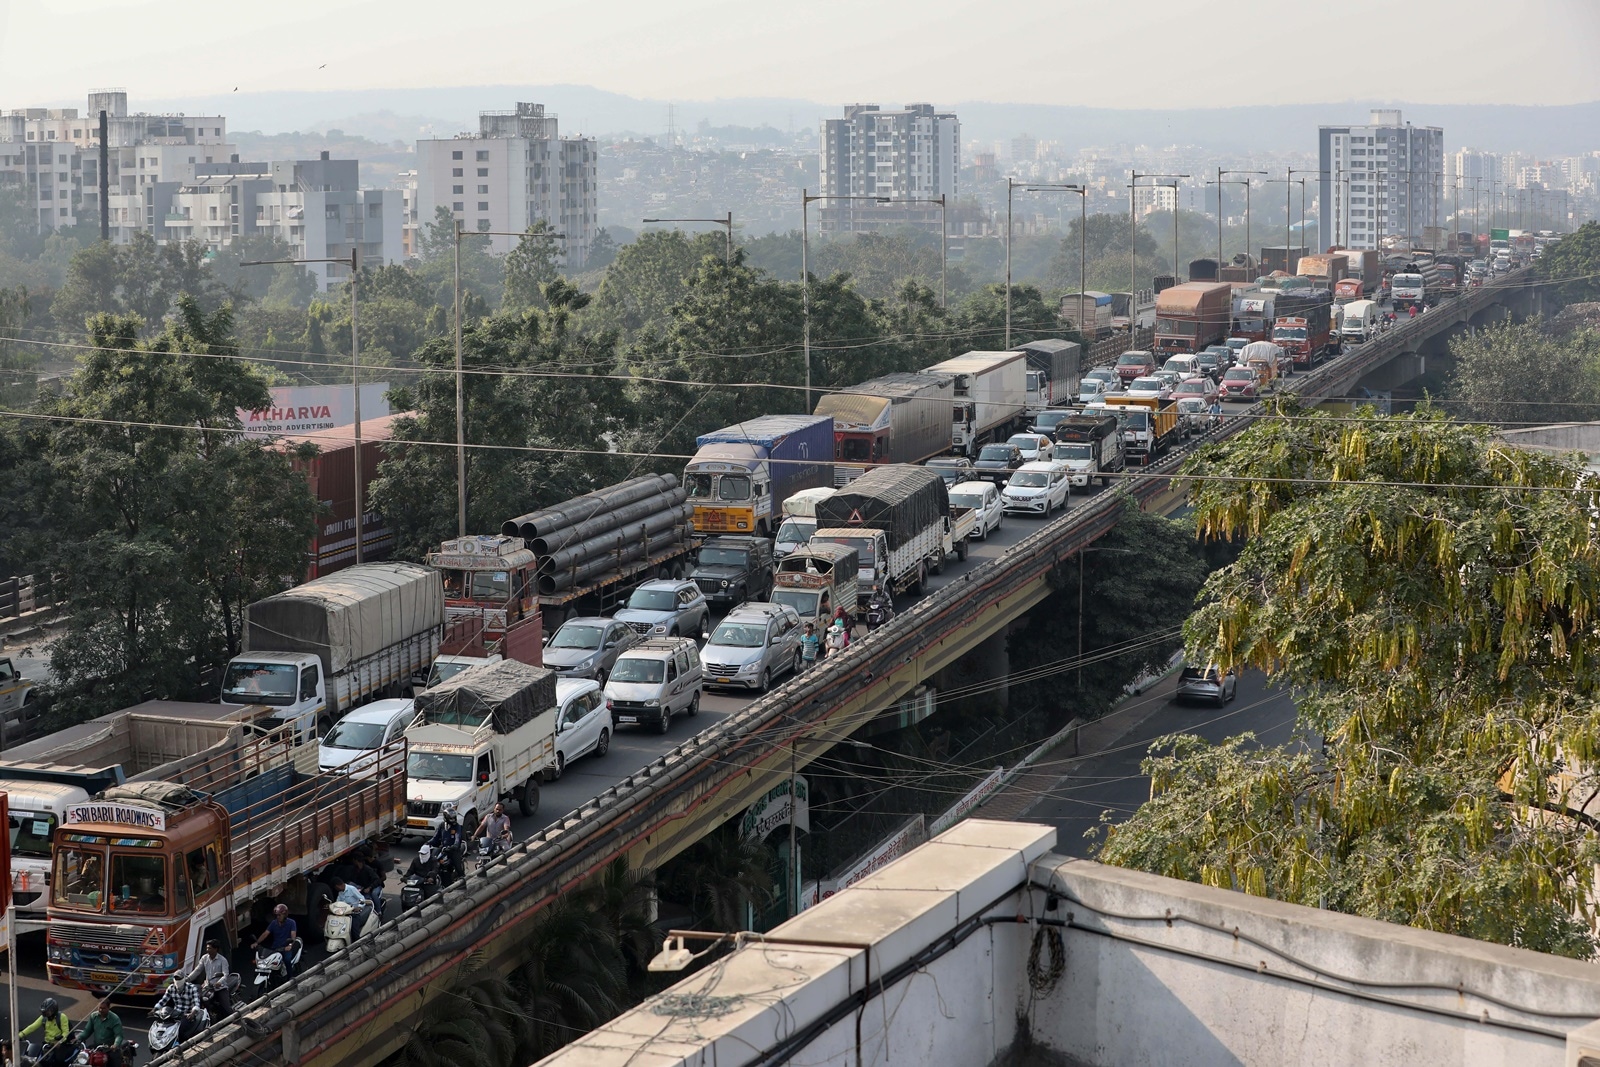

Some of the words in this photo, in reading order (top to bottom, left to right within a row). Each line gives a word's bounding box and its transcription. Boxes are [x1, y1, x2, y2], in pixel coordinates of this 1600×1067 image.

[286, 422, 334, 431] ADVERTISING
[75, 807, 90, 822] SRI
[90, 806, 115, 822] BABU
[115, 807, 155, 827] ROADWAYS
